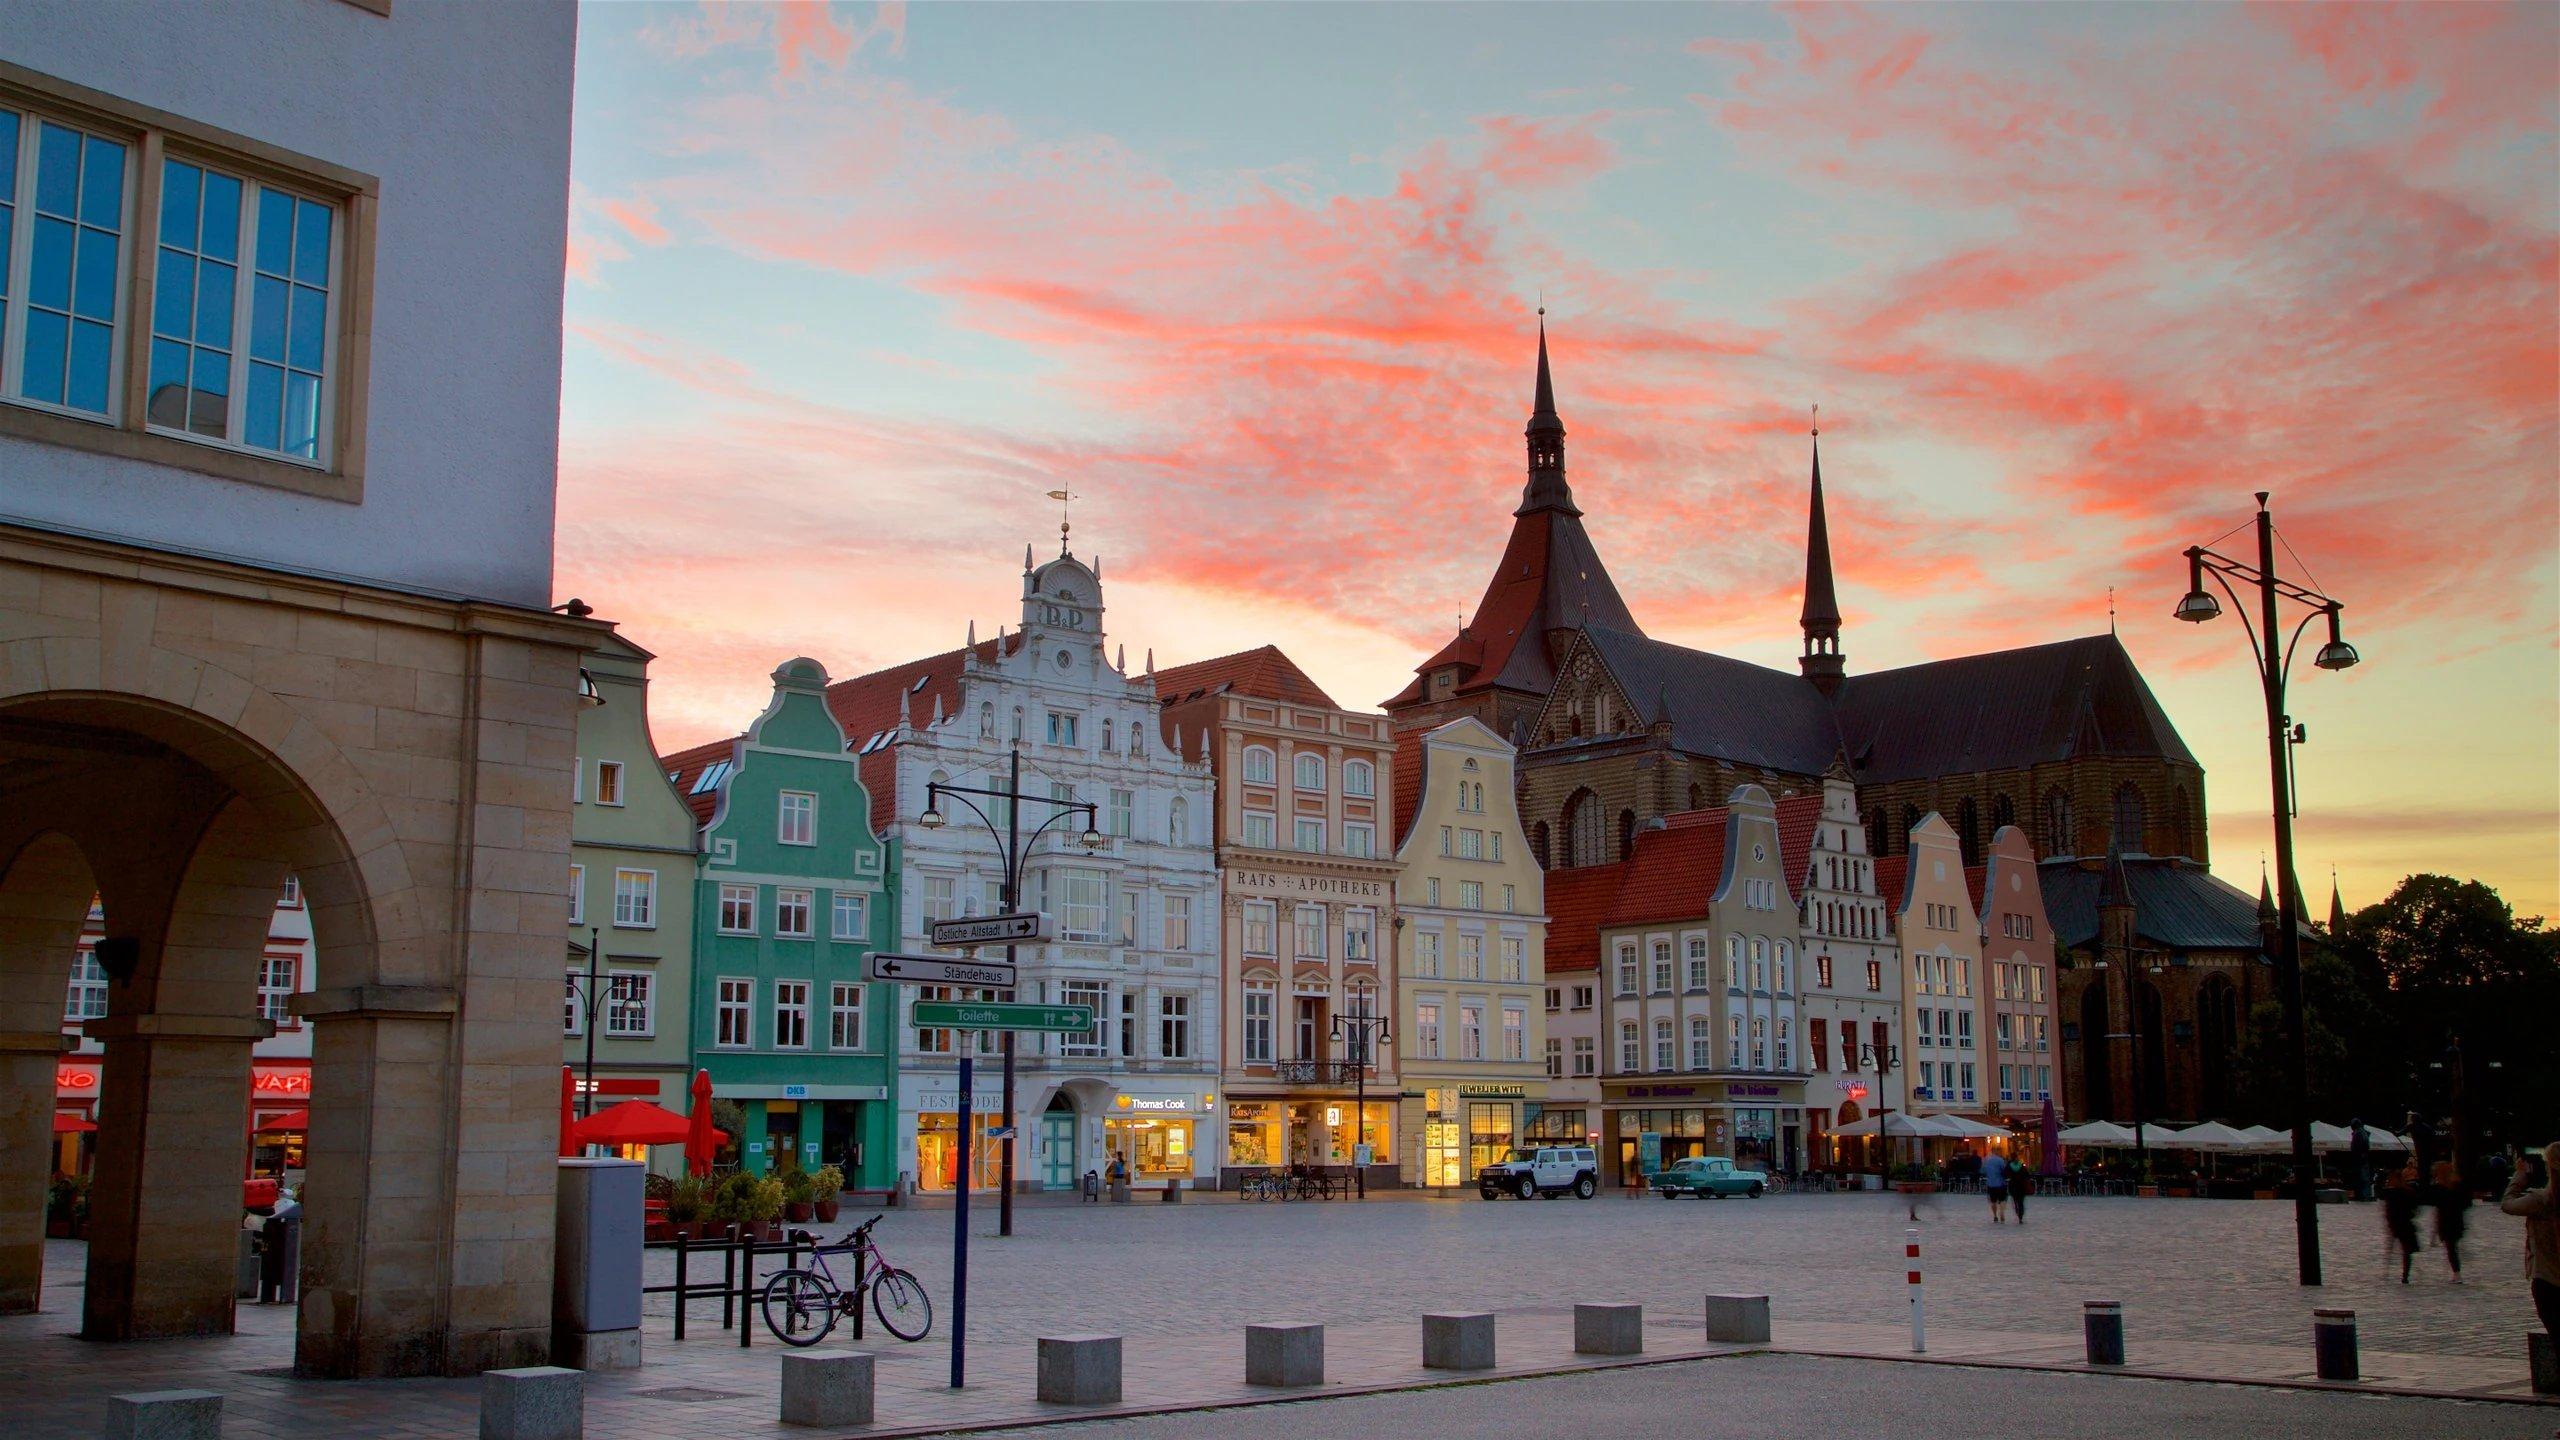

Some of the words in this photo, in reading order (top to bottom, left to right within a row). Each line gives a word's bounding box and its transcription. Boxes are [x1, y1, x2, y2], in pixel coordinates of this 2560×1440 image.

[1237, 871, 1276, 888] RATS
[1298, 877, 1381, 896] APOTHEKE
[938, 926, 968, 941] Östliche
[971, 924, 1001, 938] Altstadt
[944, 966, 1003, 982] Ständehaus
[957, 1009, 999, 1022] Toilette
[256, 1073, 309, 1092] VAPI
[787, 1086, 806, 1095] DKB
[1459, 1085, 1500, 1093] JUWELIER
[1501, 1085, 1523, 1094] WITT
[920, 1095, 1001, 1108] FESTODE
[1132, 1099, 1164, 1109] Thomas
[1165, 1099, 1186, 1109] Cook
